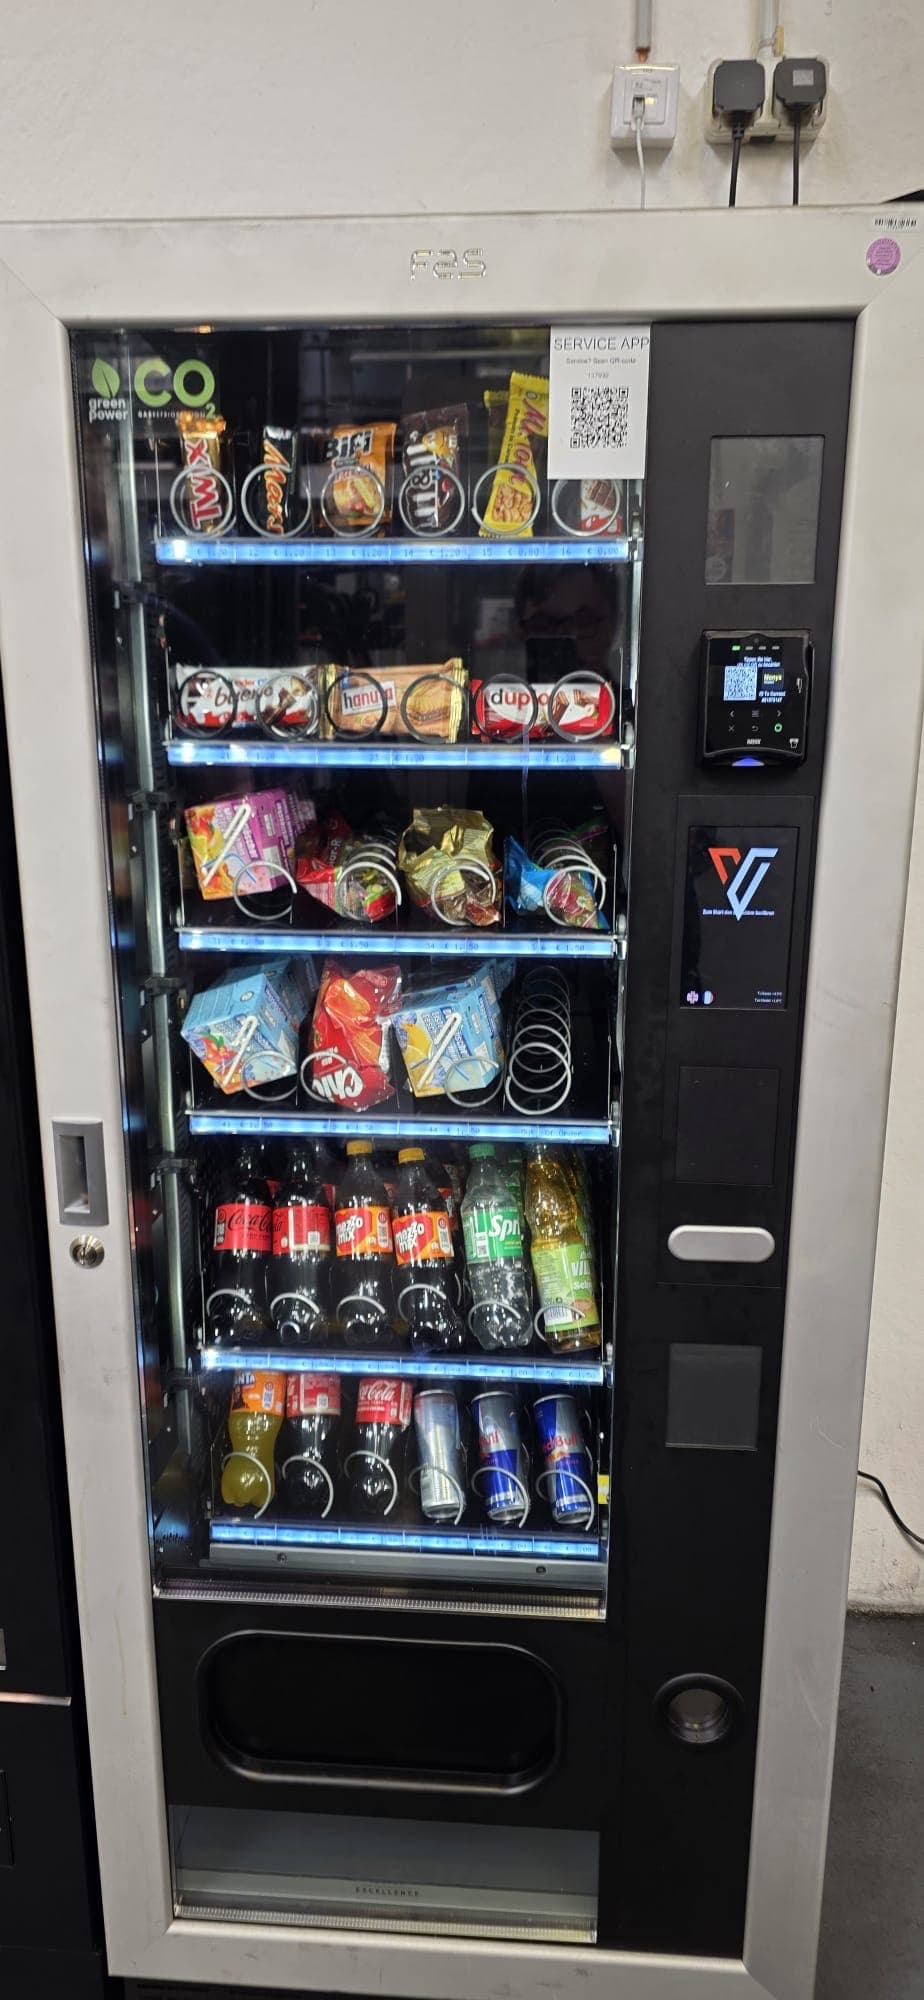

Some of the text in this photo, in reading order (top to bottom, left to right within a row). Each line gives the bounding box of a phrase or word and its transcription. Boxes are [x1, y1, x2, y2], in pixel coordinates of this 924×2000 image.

[554, 336, 650, 351] SERVICE APP
[88, 398, 126, 411] green
[88, 409, 129, 423] power
[263, 439, 290, 536] Mars
[343, 686, 394, 710] hanua
[490, 689, 549, 711] dupo
[395, 1221, 425, 1243] mezzo
[399, 1236, 418, 1254] mix
